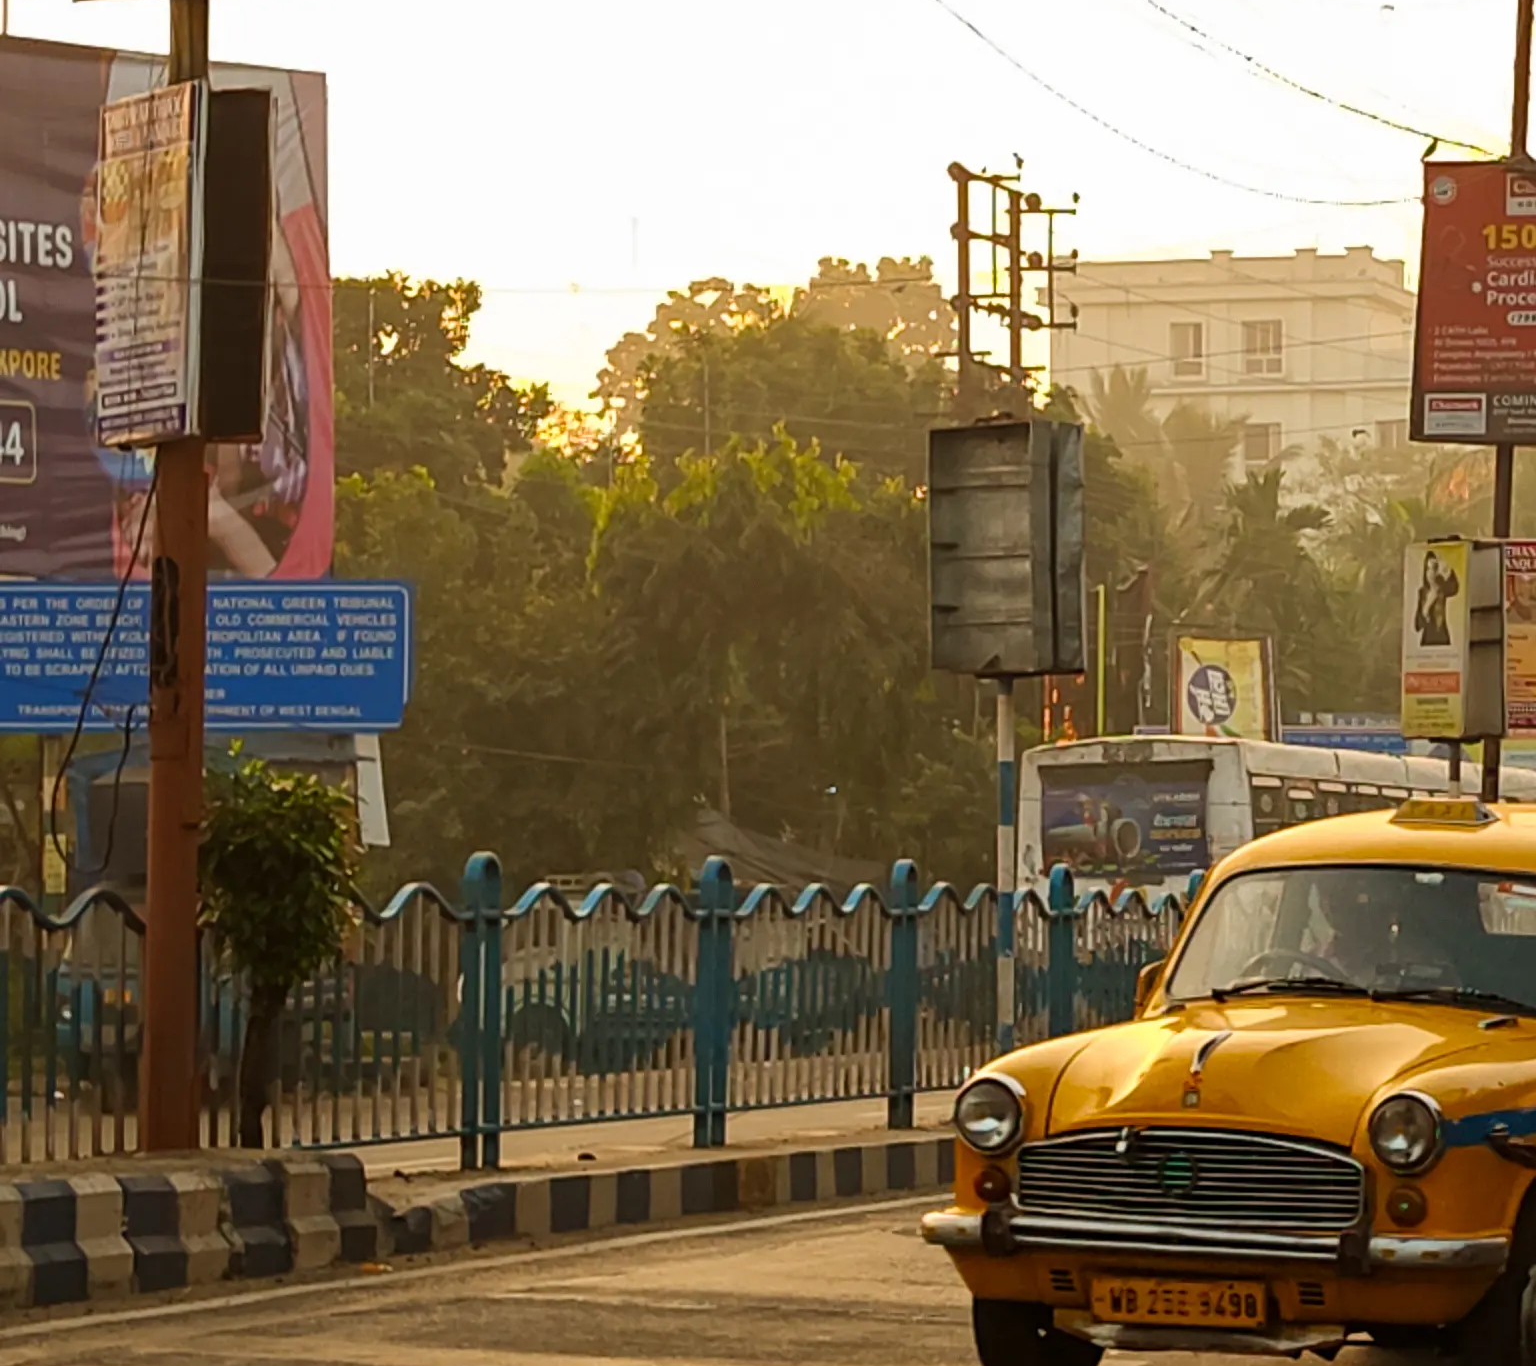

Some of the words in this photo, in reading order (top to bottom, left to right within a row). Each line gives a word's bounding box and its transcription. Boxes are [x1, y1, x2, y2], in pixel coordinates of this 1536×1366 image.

[12, 597, 39, 610] PER
[45, 597, 69, 610] THE
[75, 597, 121, 611] ORDE
[127, 597, 145, 610] OF
[212, 596, 275, 610] NATIONAL
[281, 596, 327, 610] GREEN
[333, 596, 396, 610] TRIBUNAL
[0, 614, 50, 627] ASTERN
[55, 614, 90, 627] ZONE
[215, 614, 242, 626] OLD
[247, 613, 331, 627] COMMERCIAL
[335, 613, 397, 627] VEHICLES
[0, 631, 65, 644] GISTERED
[119, 631, 150, 643] KOL
[207, 630, 282, 643] TROPOLITAN
[335, 631, 347, 643] IF
[353, 630, 397, 643] FOUND
[0, 647, 30, 660] YING
[36, 647, 74, 660] SHALL
[80, 647, 97, 660] BE
[234, 646, 316, 660] PROSECUTED
[320, 647, 347, 660] AND
[352, 647, 395, 660] LIABLE
[4, 664, 22, 676] TO
[24, 664, 42, 676] BE
[115, 664, 150, 676] AFTE
[204, 663, 241, 676] ATION
[243, 664, 261, 676] OF
[263, 664, 288, 676] ALL
[290, 663, 338, 676] UNPAID
[17, 704, 82, 716] TRANSPOR
[259, 705, 277, 717] OF
[279, 705, 313, 717] WEST
[315, 705, 363, 717] BENGAL
[1108, 1285, 1139, 1314] WB
